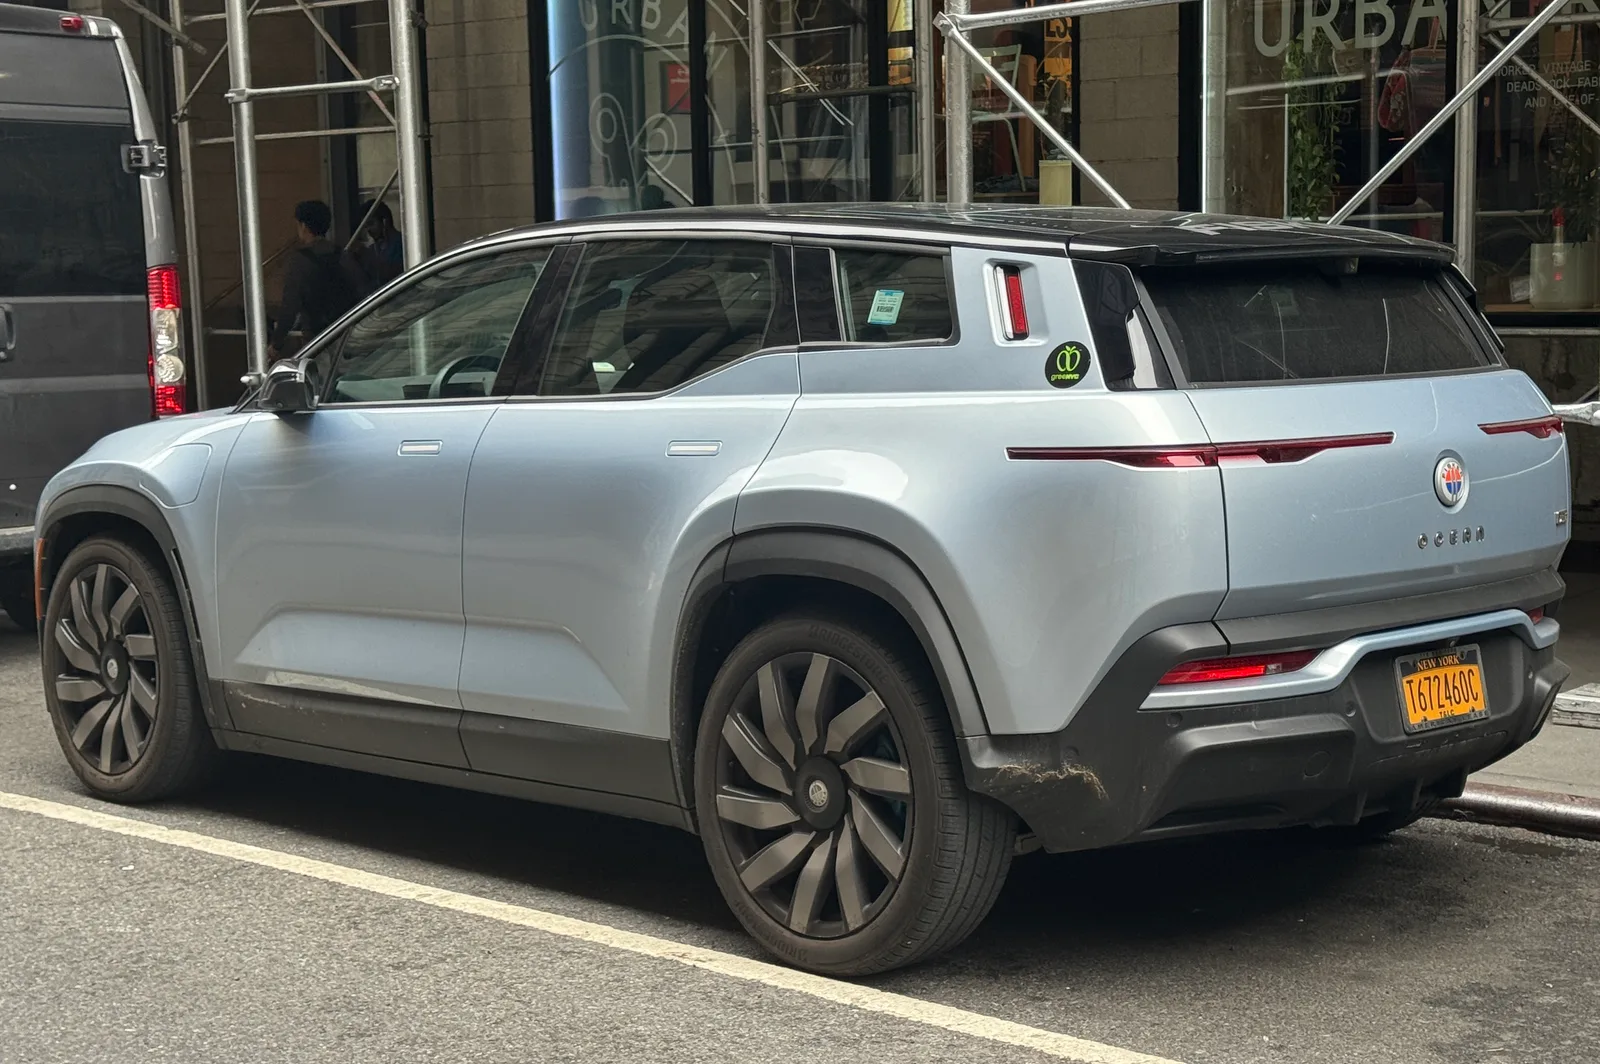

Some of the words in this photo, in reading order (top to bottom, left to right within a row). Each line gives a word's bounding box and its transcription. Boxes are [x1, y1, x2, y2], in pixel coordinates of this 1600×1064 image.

[1543, 59, 1591, 74] VINTAGE
[1506, 75, 1571, 93] DEADSOCK
[1524, 96, 1547, 109] AND
[1417, 525, 1485, 550] OCEAN
[808, 623, 890, 685] BRIDGESTONE
[1417, 657, 1437, 671] NEW
[1438, 654, 1460, 666] YORK
[1406, 668, 1479, 714] T672460C
